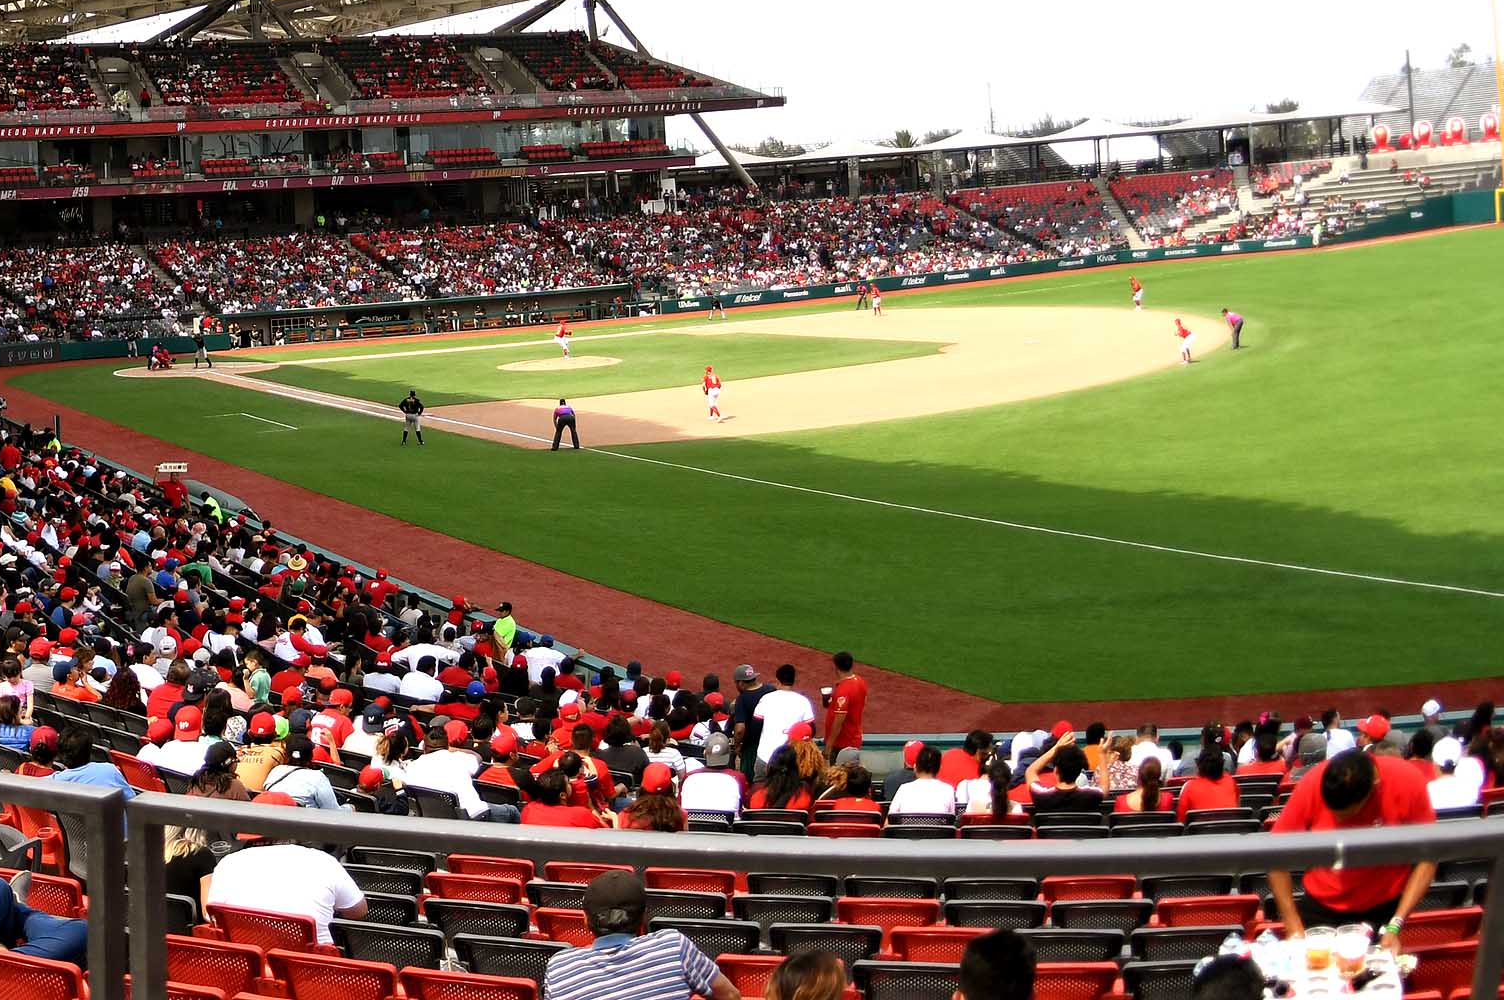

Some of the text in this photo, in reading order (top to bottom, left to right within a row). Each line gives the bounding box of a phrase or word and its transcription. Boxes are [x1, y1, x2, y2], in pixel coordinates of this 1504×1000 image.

[567, 106, 605, 116] ESTADIO
[266, 118, 309, 128] ESTADIO
[316, 116, 359, 126] ALFREDO
[366, 115, 391, 124] HARP
[34, 127, 63, 136] HARP
[72, 186, 90, 198] #59
[251, 179, 269, 188] 4.91
[442, 171, 448, 179] 0
[539, 166, 549, 174] 12
[741, 293, 762, 303] telcel
